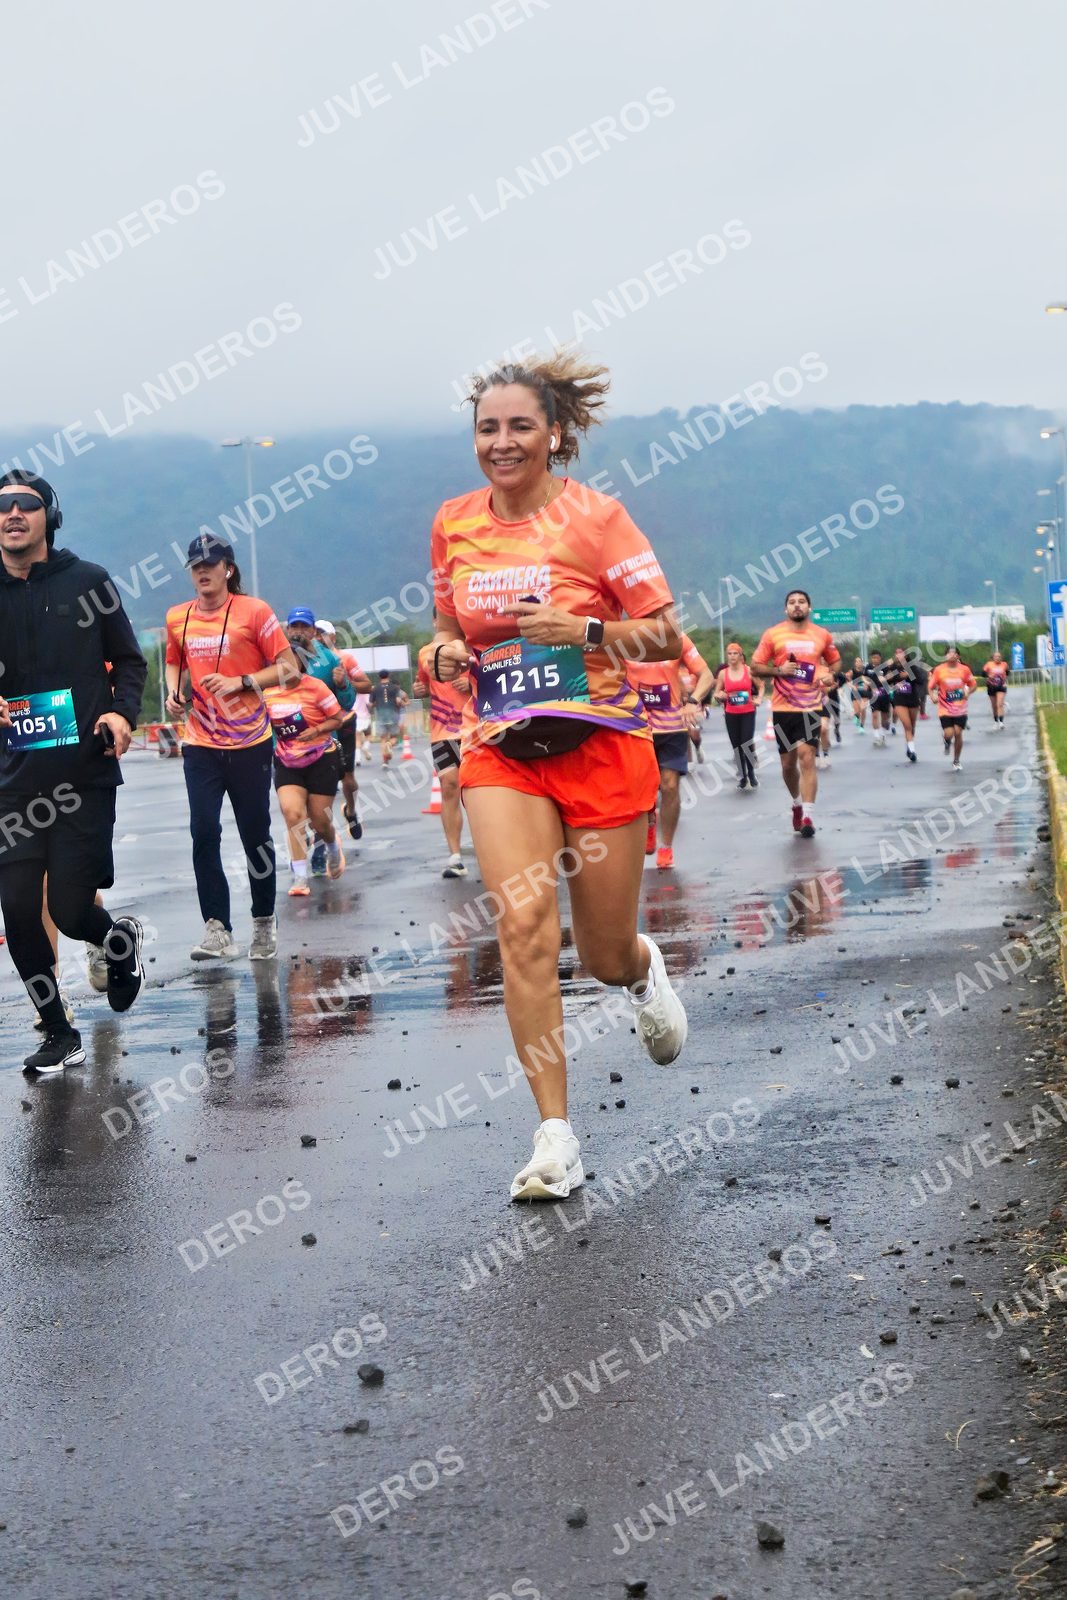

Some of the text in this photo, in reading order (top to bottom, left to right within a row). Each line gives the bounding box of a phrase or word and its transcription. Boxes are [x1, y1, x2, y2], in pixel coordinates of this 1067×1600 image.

[468, 565, 551, 592] CARRERA
[483, 644, 522, 665] CARRERA
[482, 659, 513, 673] OMNILIFE
[495, 664, 560, 695] 1215
[51, 694, 66, 707] 10K
[12, 714, 57, 736] 1051
